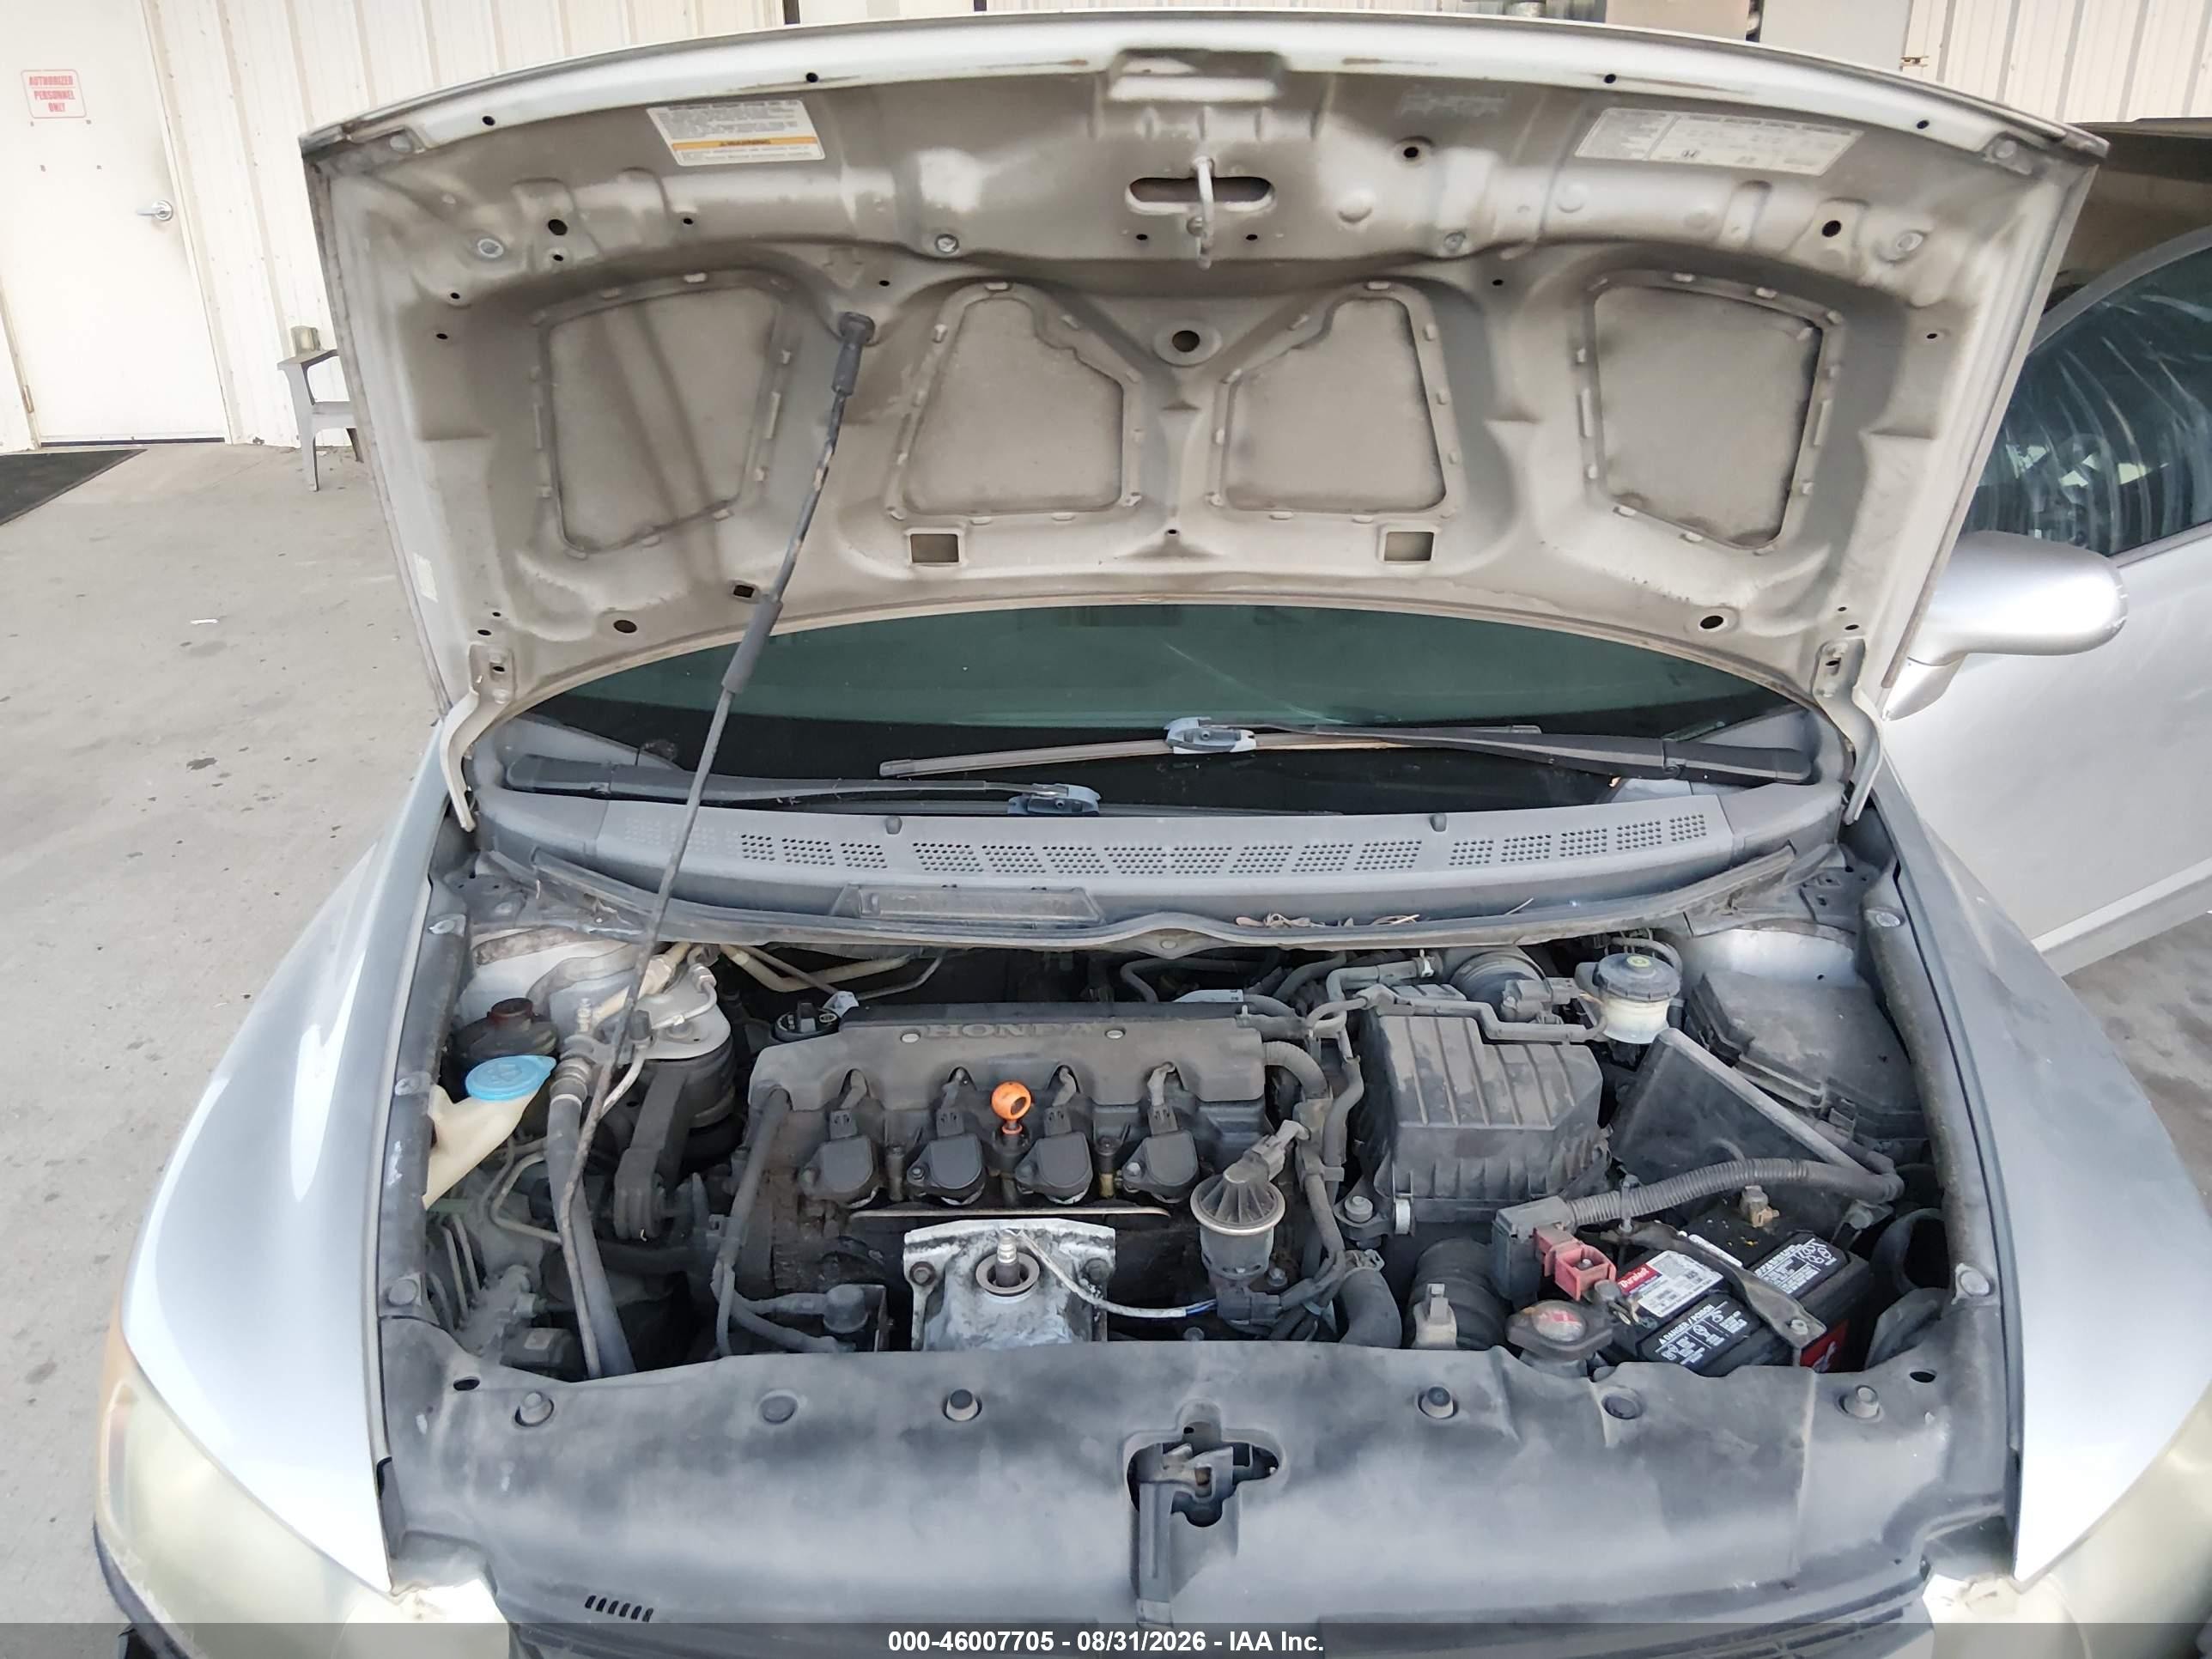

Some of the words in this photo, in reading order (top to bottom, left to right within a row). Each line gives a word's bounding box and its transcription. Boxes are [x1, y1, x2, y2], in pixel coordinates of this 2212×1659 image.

[28, 75, 74, 86] AUTHORIZED
[33, 89, 76, 100] PERSONNEL
[48, 101, 66, 112] ONLY
[926, 1023, 1096, 1038] HONDA
[1618, 1267, 1650, 1289] Duralast
[1663, 1321, 1690, 1340] DANGER
